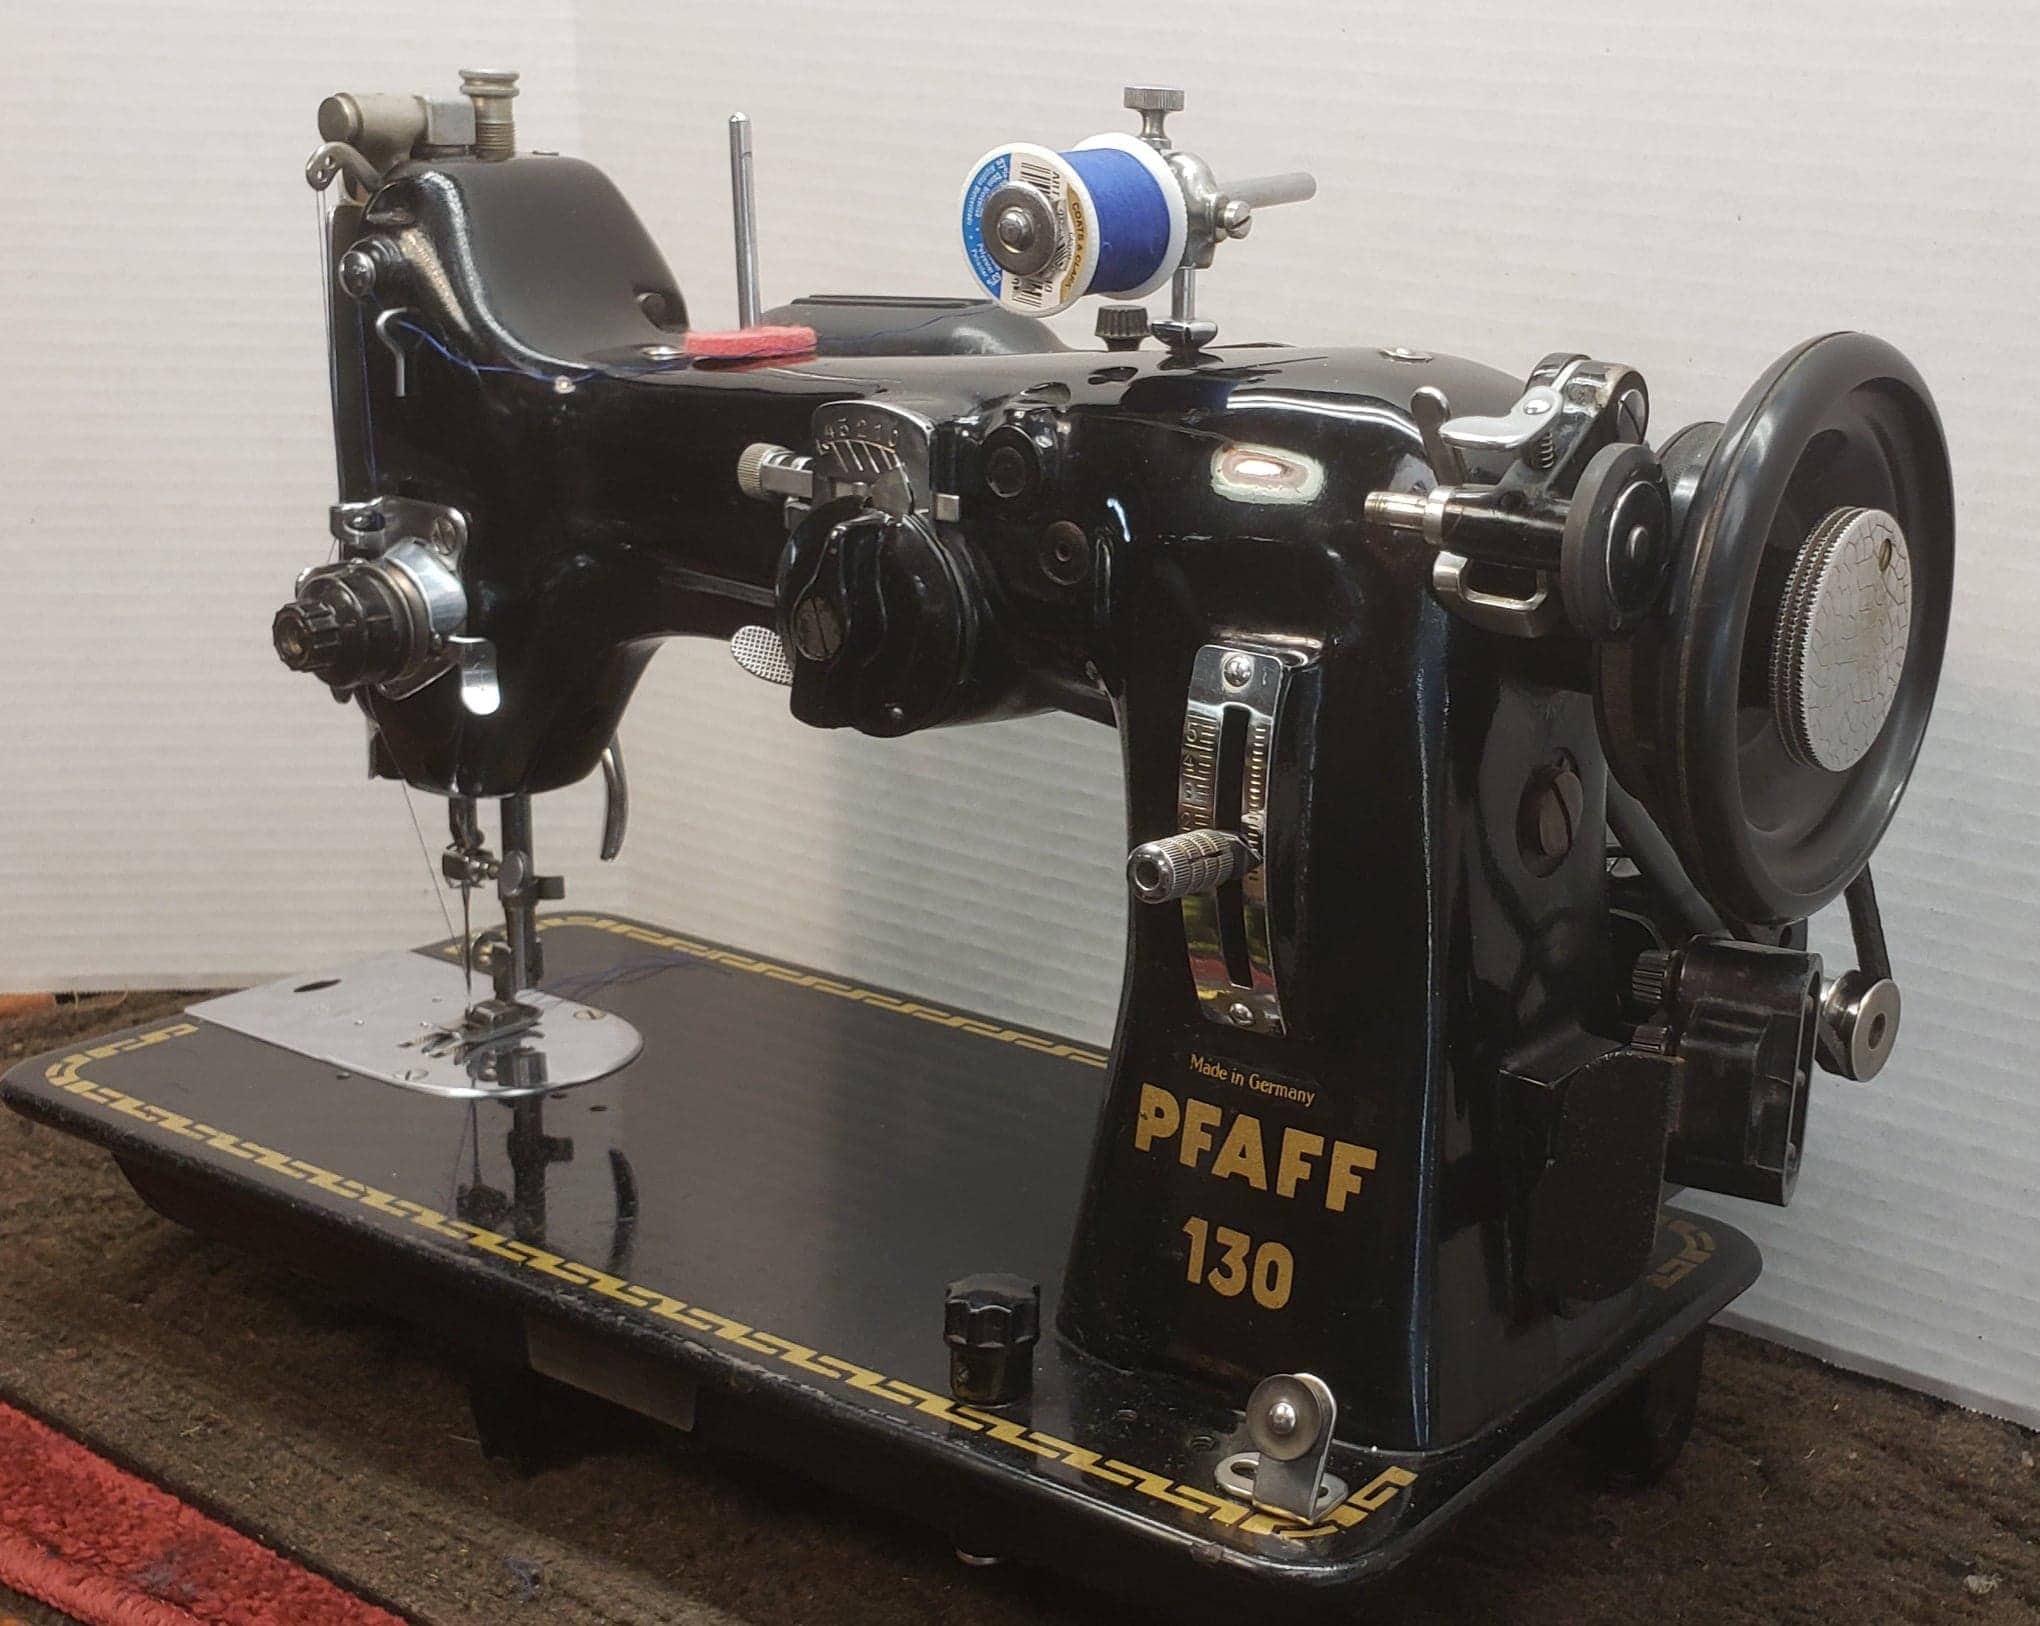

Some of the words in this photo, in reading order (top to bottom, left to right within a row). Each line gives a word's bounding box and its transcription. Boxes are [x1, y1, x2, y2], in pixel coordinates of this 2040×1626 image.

[1071, 202, 1085, 240] COATS
[1064, 254, 1081, 288] CLARK
[1186, 722, 1198, 743] 5
[1189, 1053, 1228, 1081] Made
[1230, 1067, 1245, 1087] in
[1249, 1073, 1316, 1108] Germany
[1134, 1082, 1378, 1212] PFAFF
[1182, 1215, 1294, 1310] 130
